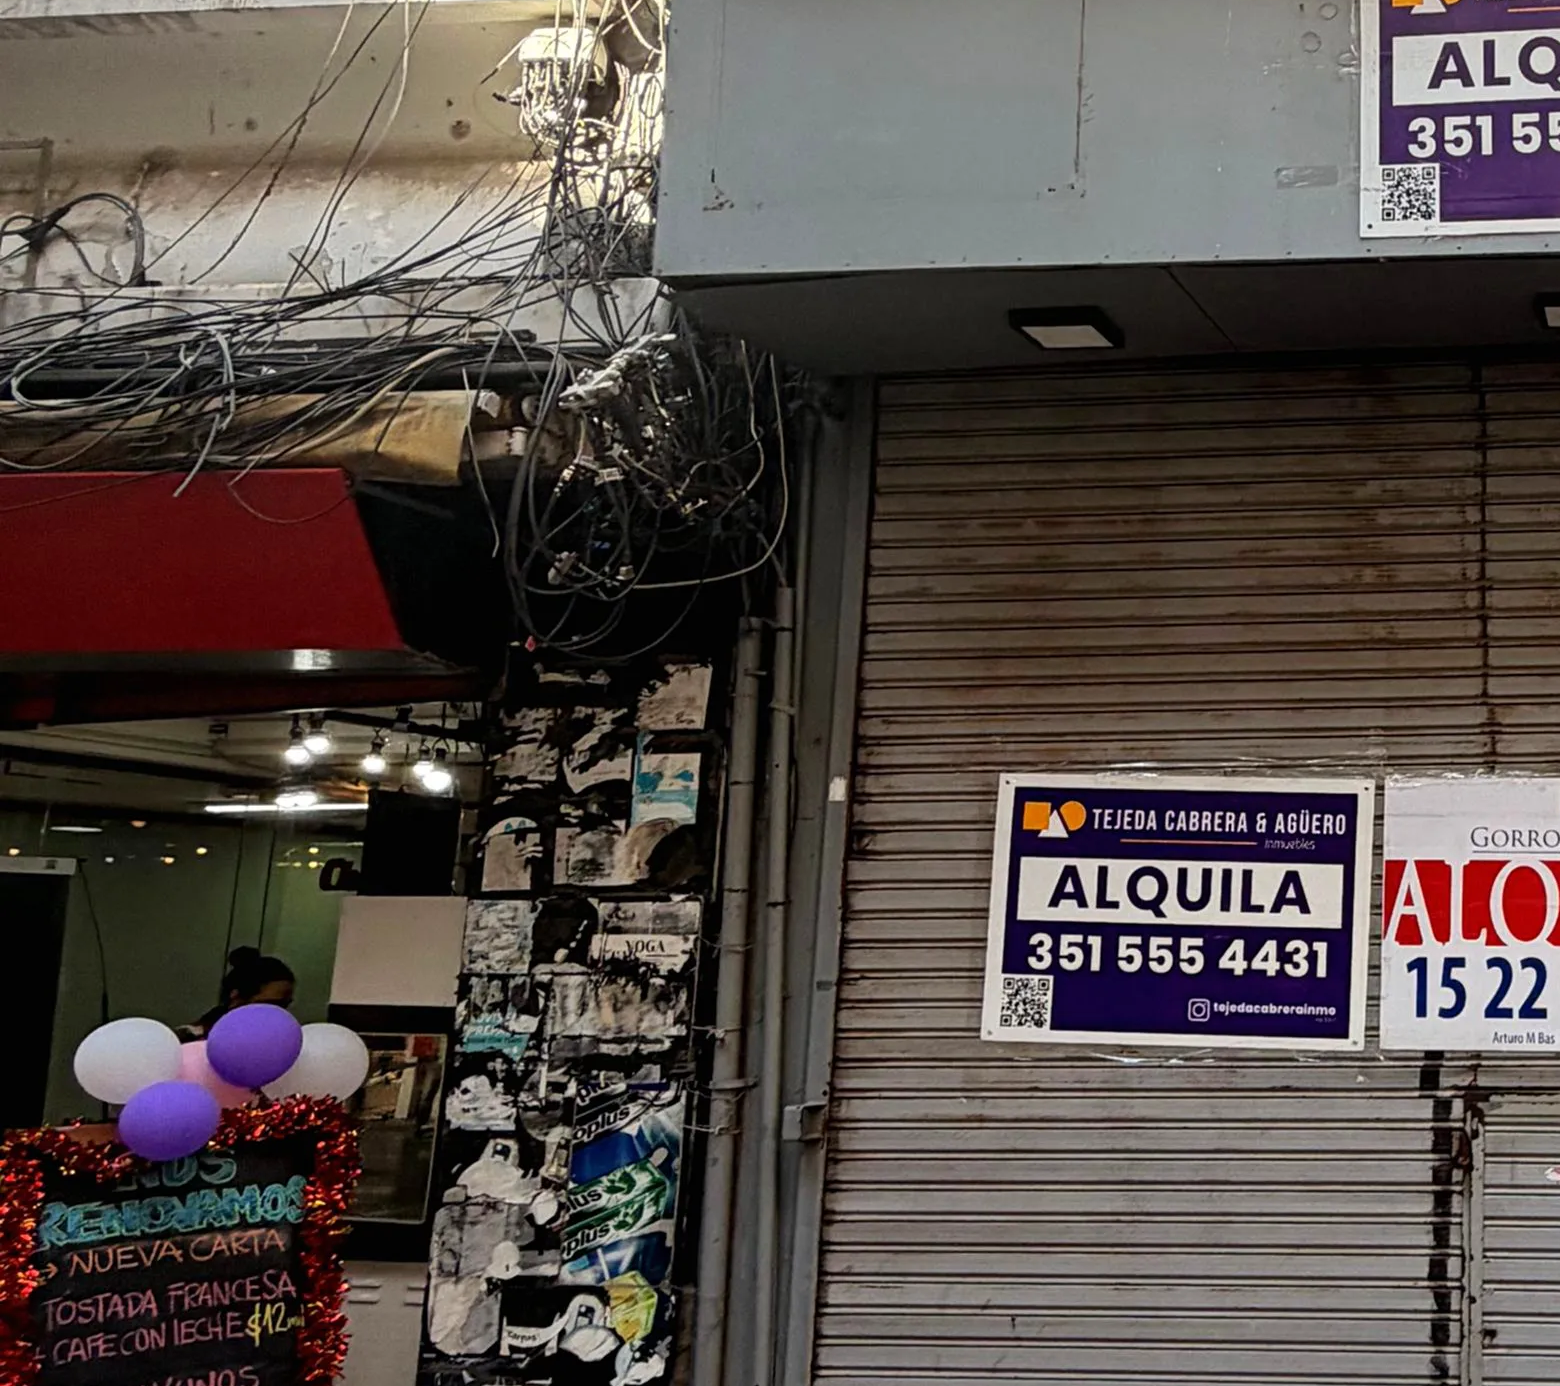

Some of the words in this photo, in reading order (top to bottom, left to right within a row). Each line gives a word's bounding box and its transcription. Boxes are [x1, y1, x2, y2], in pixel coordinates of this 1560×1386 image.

[1407, 115, 1494, 158] 351
[1092, 809, 1157, 831] TEJEDA
[1165, 810, 1248, 833] CABRERA
[1256, 813, 1266, 833] &
[1274, 809, 1346, 835] AGÜERO
[1264, 838, 1315, 850] inmuebles
[1048, 864, 1311, 918] ALQUILA
[1027, 932, 1101, 971] 351
[1117, 936, 1204, 975] 555
[1218, 939, 1327, 978] 4431
[1406, 957, 1467, 1018] 15
[1484, 957, 1547, 1019] 22
[1492, 1031, 1524, 1044] Arturo
[1526, 1032, 1536, 1044] M
[1538, 1032, 1555, 1044] Bas
[37, 1175, 306, 1251] RENOVAMOS
[69, 1240, 183, 1277] NUEVA
[189, 1228, 286, 1261] CARTA
[41, 1289, 158, 1330] TOSTADA
[167, 1270, 297, 1311] FRANCESA
